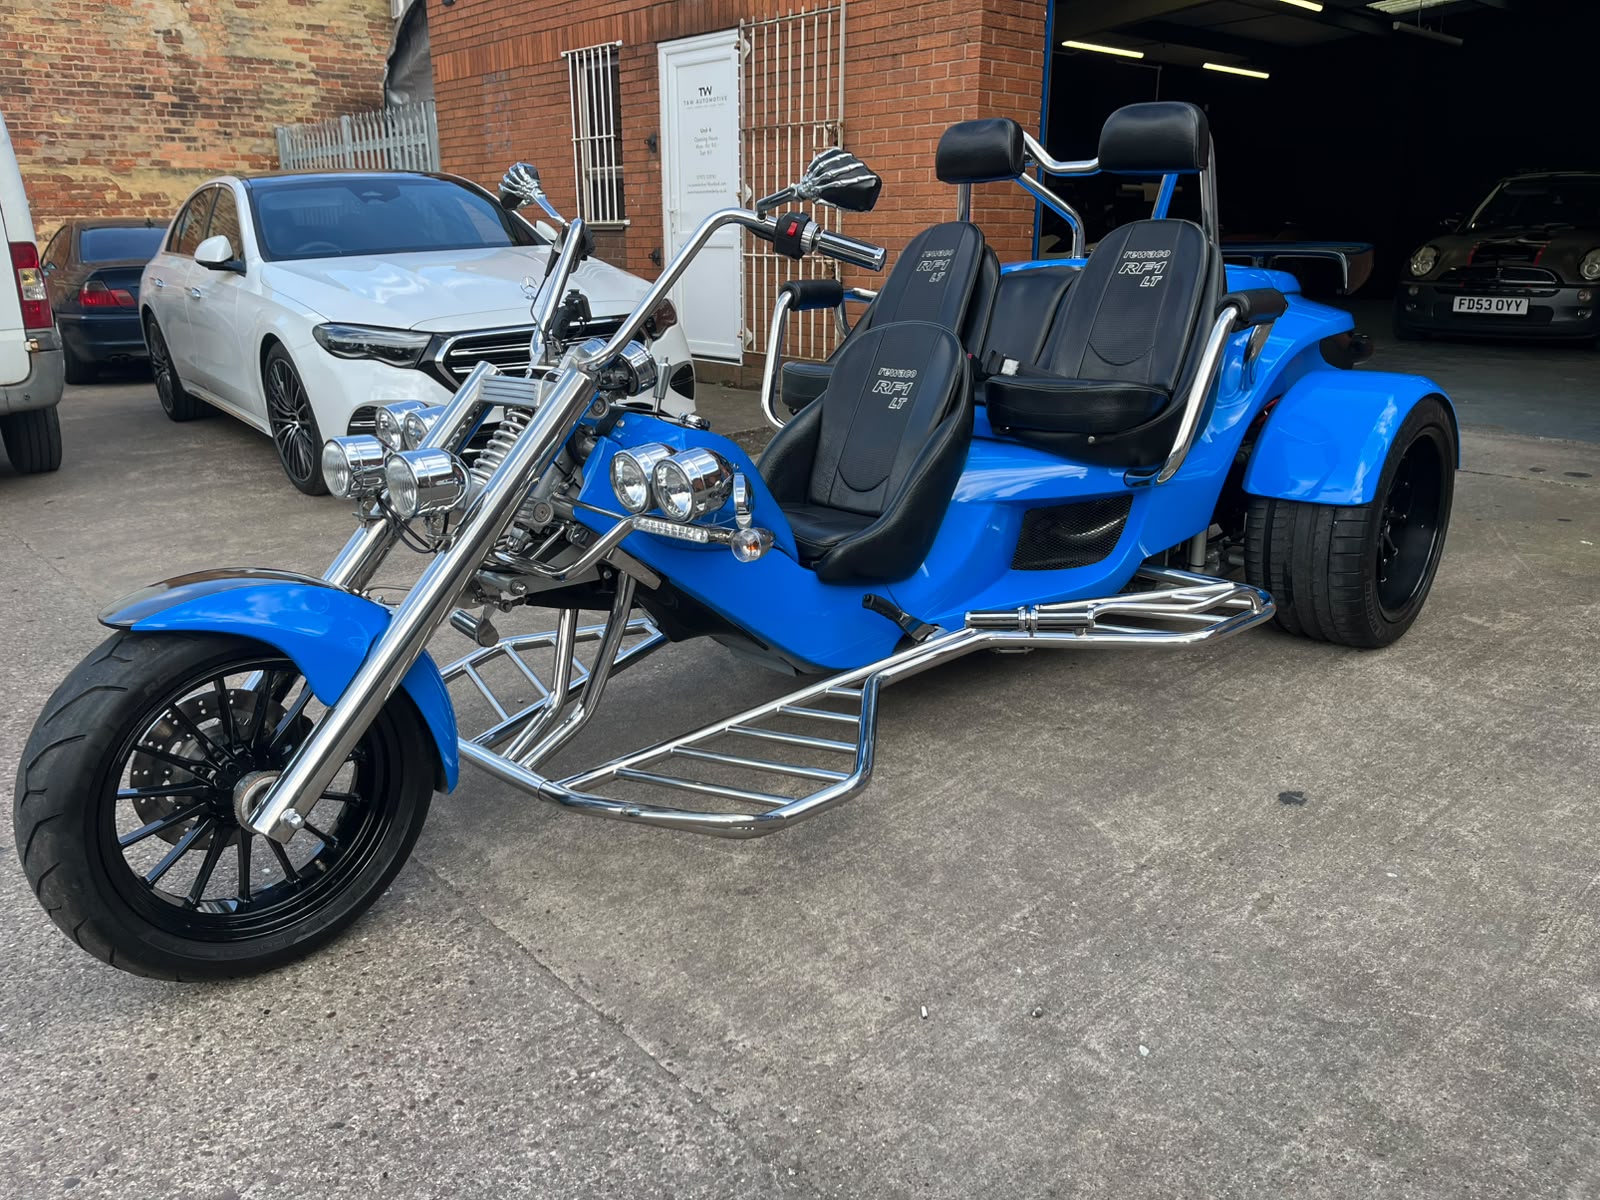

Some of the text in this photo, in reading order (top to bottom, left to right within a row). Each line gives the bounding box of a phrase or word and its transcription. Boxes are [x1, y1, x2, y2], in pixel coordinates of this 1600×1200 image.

[698, 86, 712, 96] TW
[695, 96, 727, 104] AUTOMOTIVE
[1123, 250, 1171, 259] rewaco
[916, 259, 951, 271] RF1
[1118, 261, 1168, 275] RF1
[929, 271, 946, 282] LT
[1139, 275, 1163, 287] LT
[1458, 298, 1522, 312] FD53 OYY
[878, 367, 917, 378] rewaco
[872, 379, 914, 396] RF1
[888, 397, 908, 410] LT
